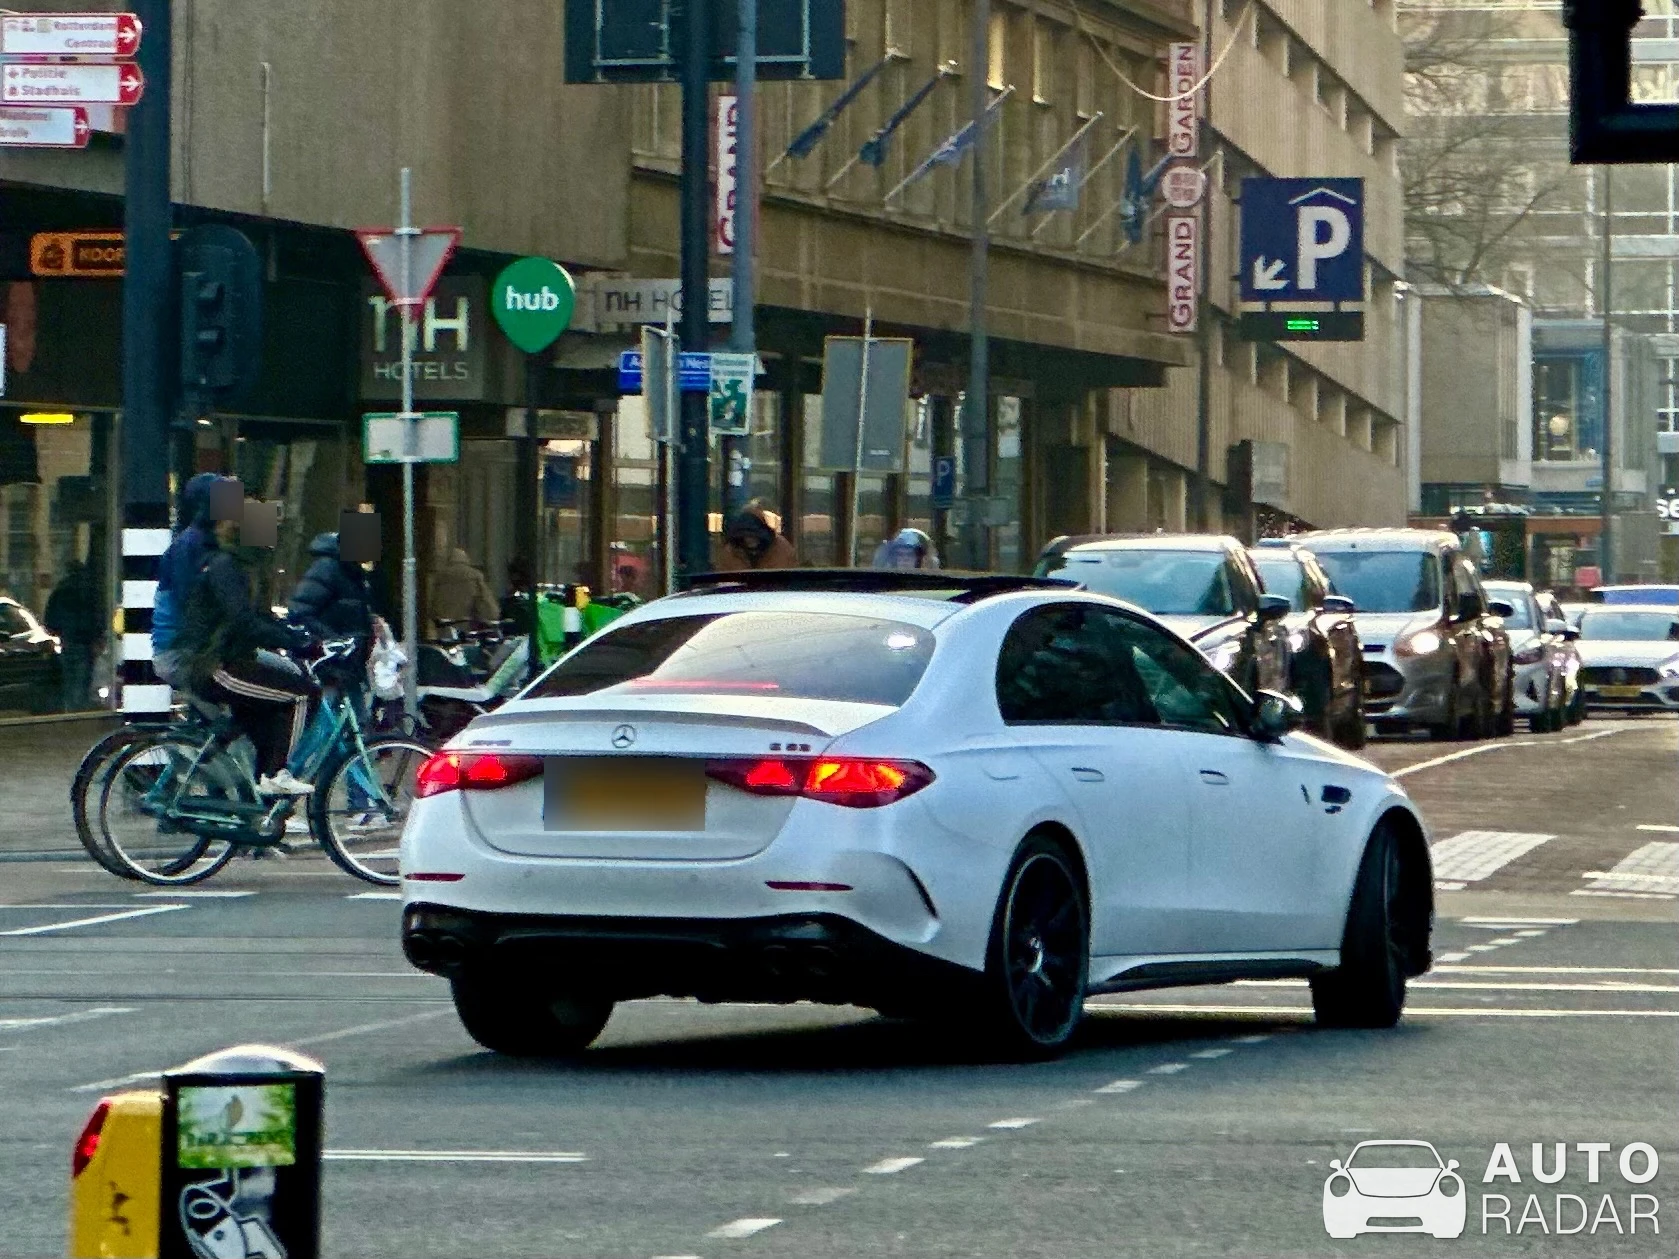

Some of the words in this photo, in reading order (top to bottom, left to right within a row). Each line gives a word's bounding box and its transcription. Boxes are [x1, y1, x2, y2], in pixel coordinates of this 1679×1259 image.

[1170, 46, 1193, 153] GARDEN
[1171, 221, 1192, 327] GRAND
[1297, 206, 1350, 290] P
[506, 285, 560, 310] hub
[374, 361, 468, 380] HOTELS
